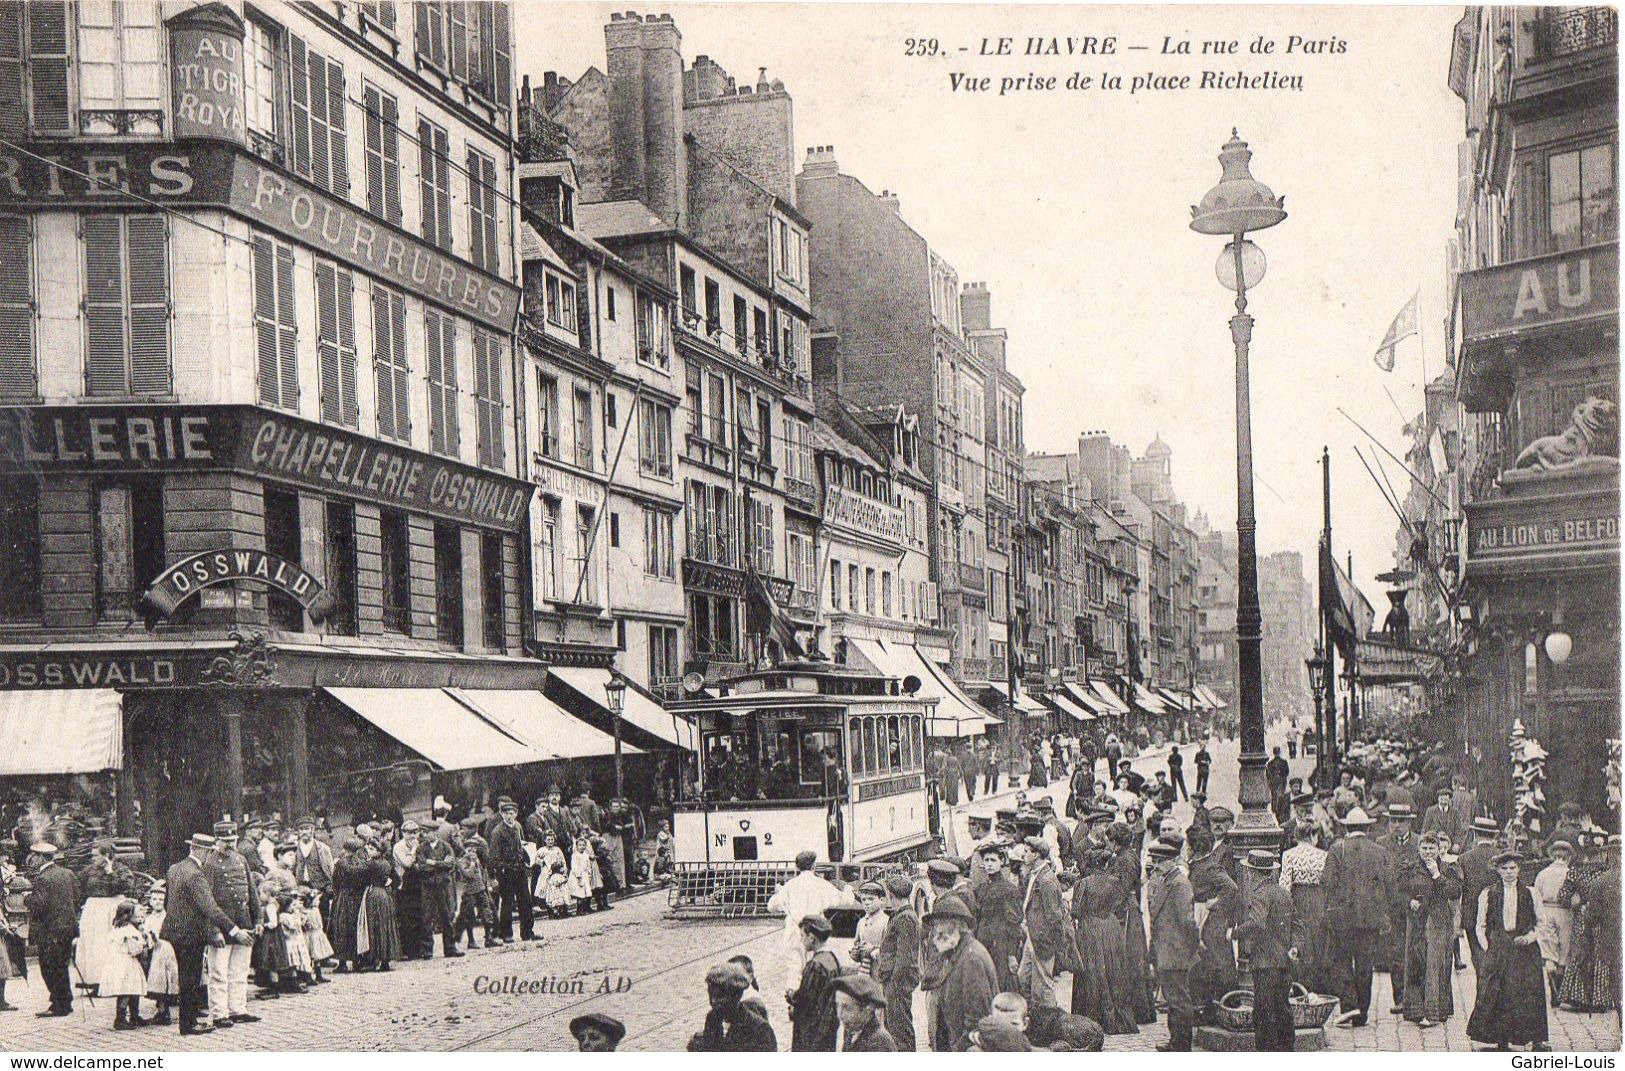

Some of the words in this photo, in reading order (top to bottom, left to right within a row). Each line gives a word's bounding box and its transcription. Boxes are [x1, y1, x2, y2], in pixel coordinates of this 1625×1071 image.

[194, 38, 237, 62] AU
[252, 169, 503, 318] FOURRURES
[1513, 258, 1592, 320] AU
[251, 419, 422, 501] CHAPELLERIE
[430, 471, 524, 523] OSSWALD
[1480, 528, 1498, 549] AU
[1503, 524, 1539, 547] LION
[1564, 517, 1621, 542] BELFO
[172, 551, 312, 595] OSSWALD
[764, 832, 773, 846] 2
